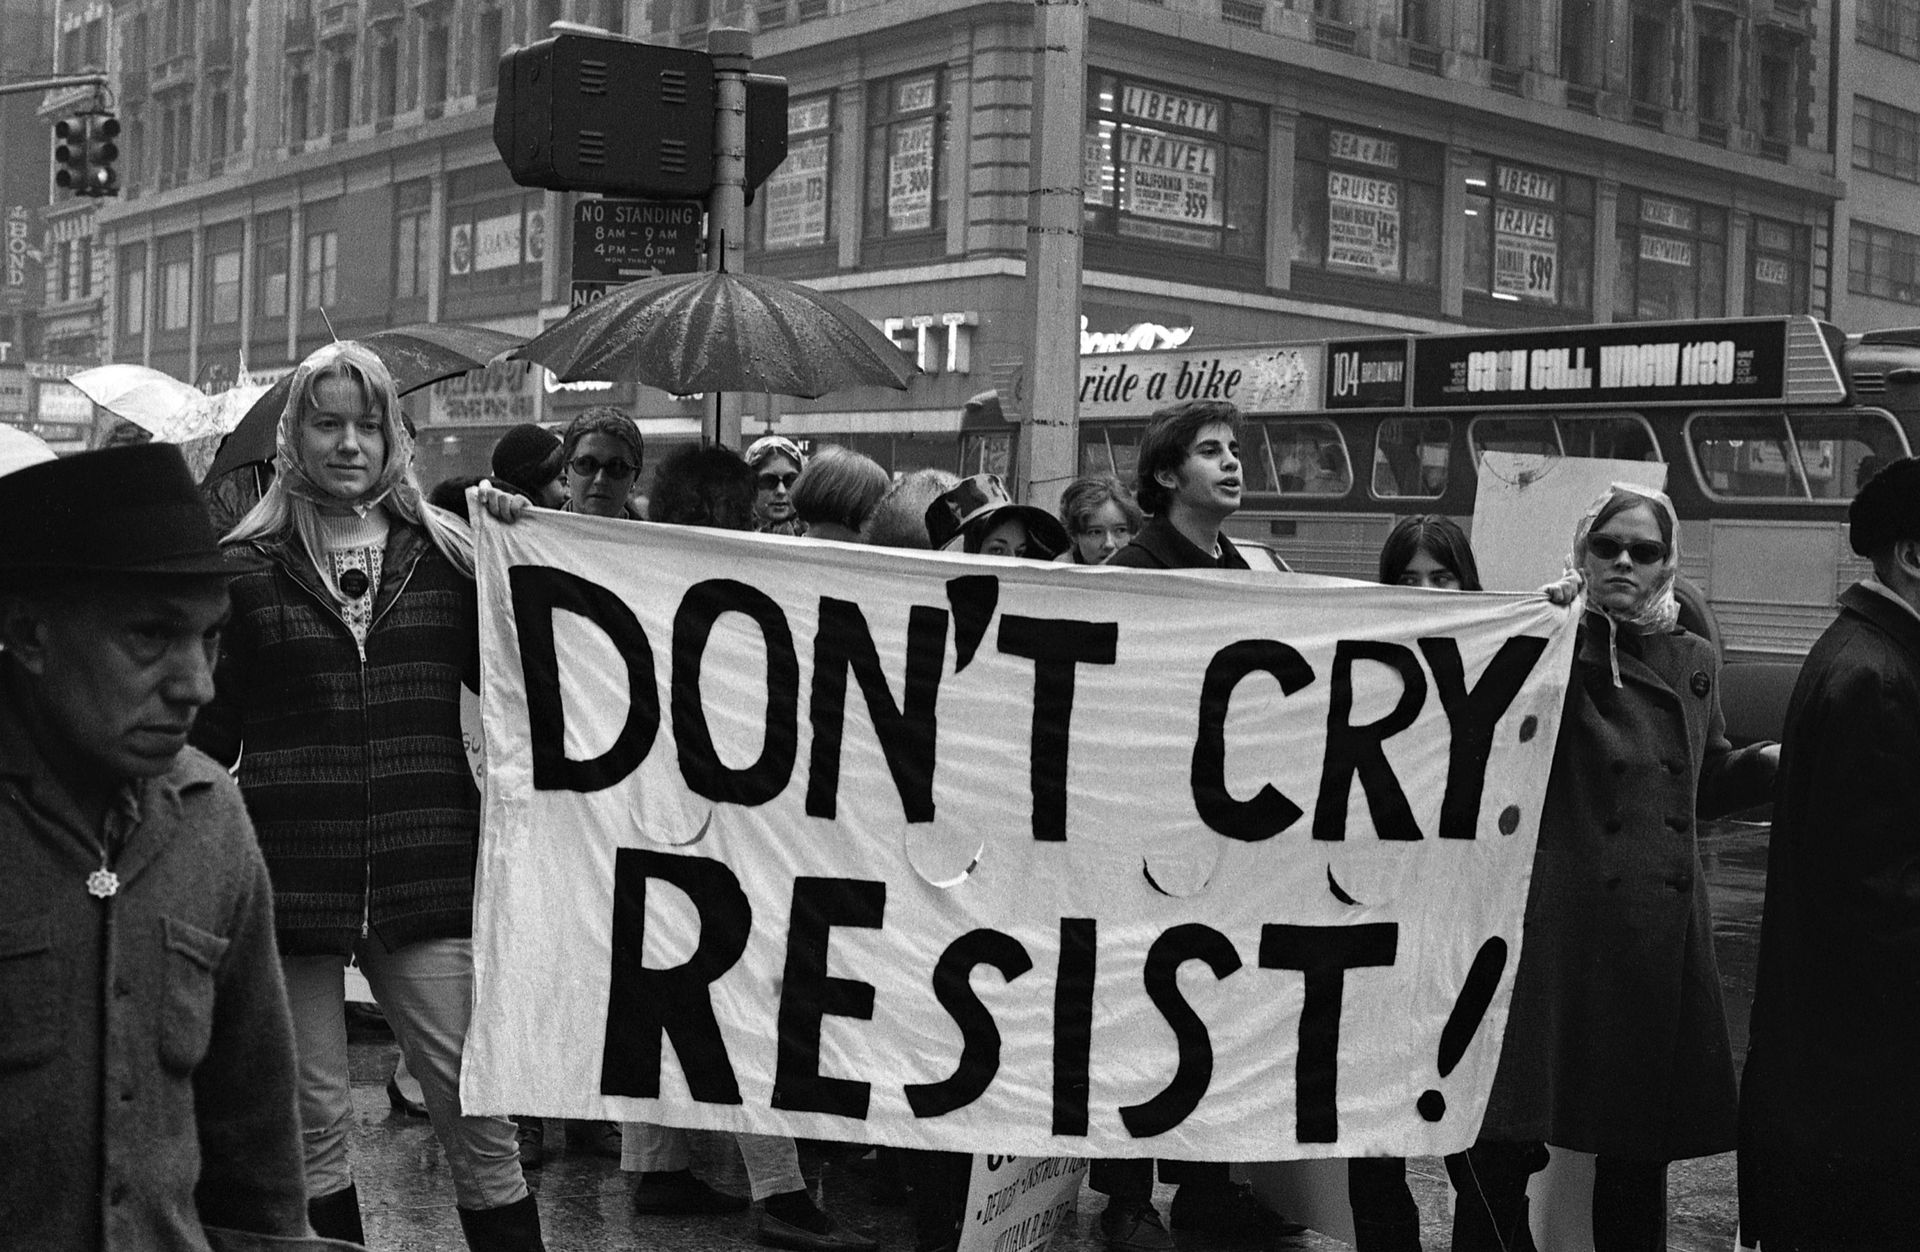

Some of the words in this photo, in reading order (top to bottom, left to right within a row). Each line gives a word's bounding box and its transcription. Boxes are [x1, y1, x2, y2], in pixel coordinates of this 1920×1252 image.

[1126, 88, 1215, 128] LIBERTY
[1124, 135, 1211, 173] TRAVEL
[1330, 130, 1359, 159] SEA
[1374, 141, 1398, 168] AIR
[1135, 170, 1182, 192] CALIFORNIA
[1330, 174, 1397, 206] CRUISES
[1497, 166, 1553, 199] LIBERTY
[582, 205, 604, 222] NO
[615, 206, 693, 224] STANDING
[1185, 191, 1207, 219] 359
[1495, 207, 1552, 237] TRAVEL
[1529, 254, 1552, 291] 599
[1080, 364, 1138, 403] ride
[1147, 371, 1168, 401] a
[1175, 359, 1242, 400] bike
[1333, 351, 1359, 397] 104
[1361, 361, 1404, 383] BROADWAY
[1530, 347, 1592, 390] CALL
[509, 566, 1117, 841] DON'T
[600, 847, 1508, 1144] RESIST!
